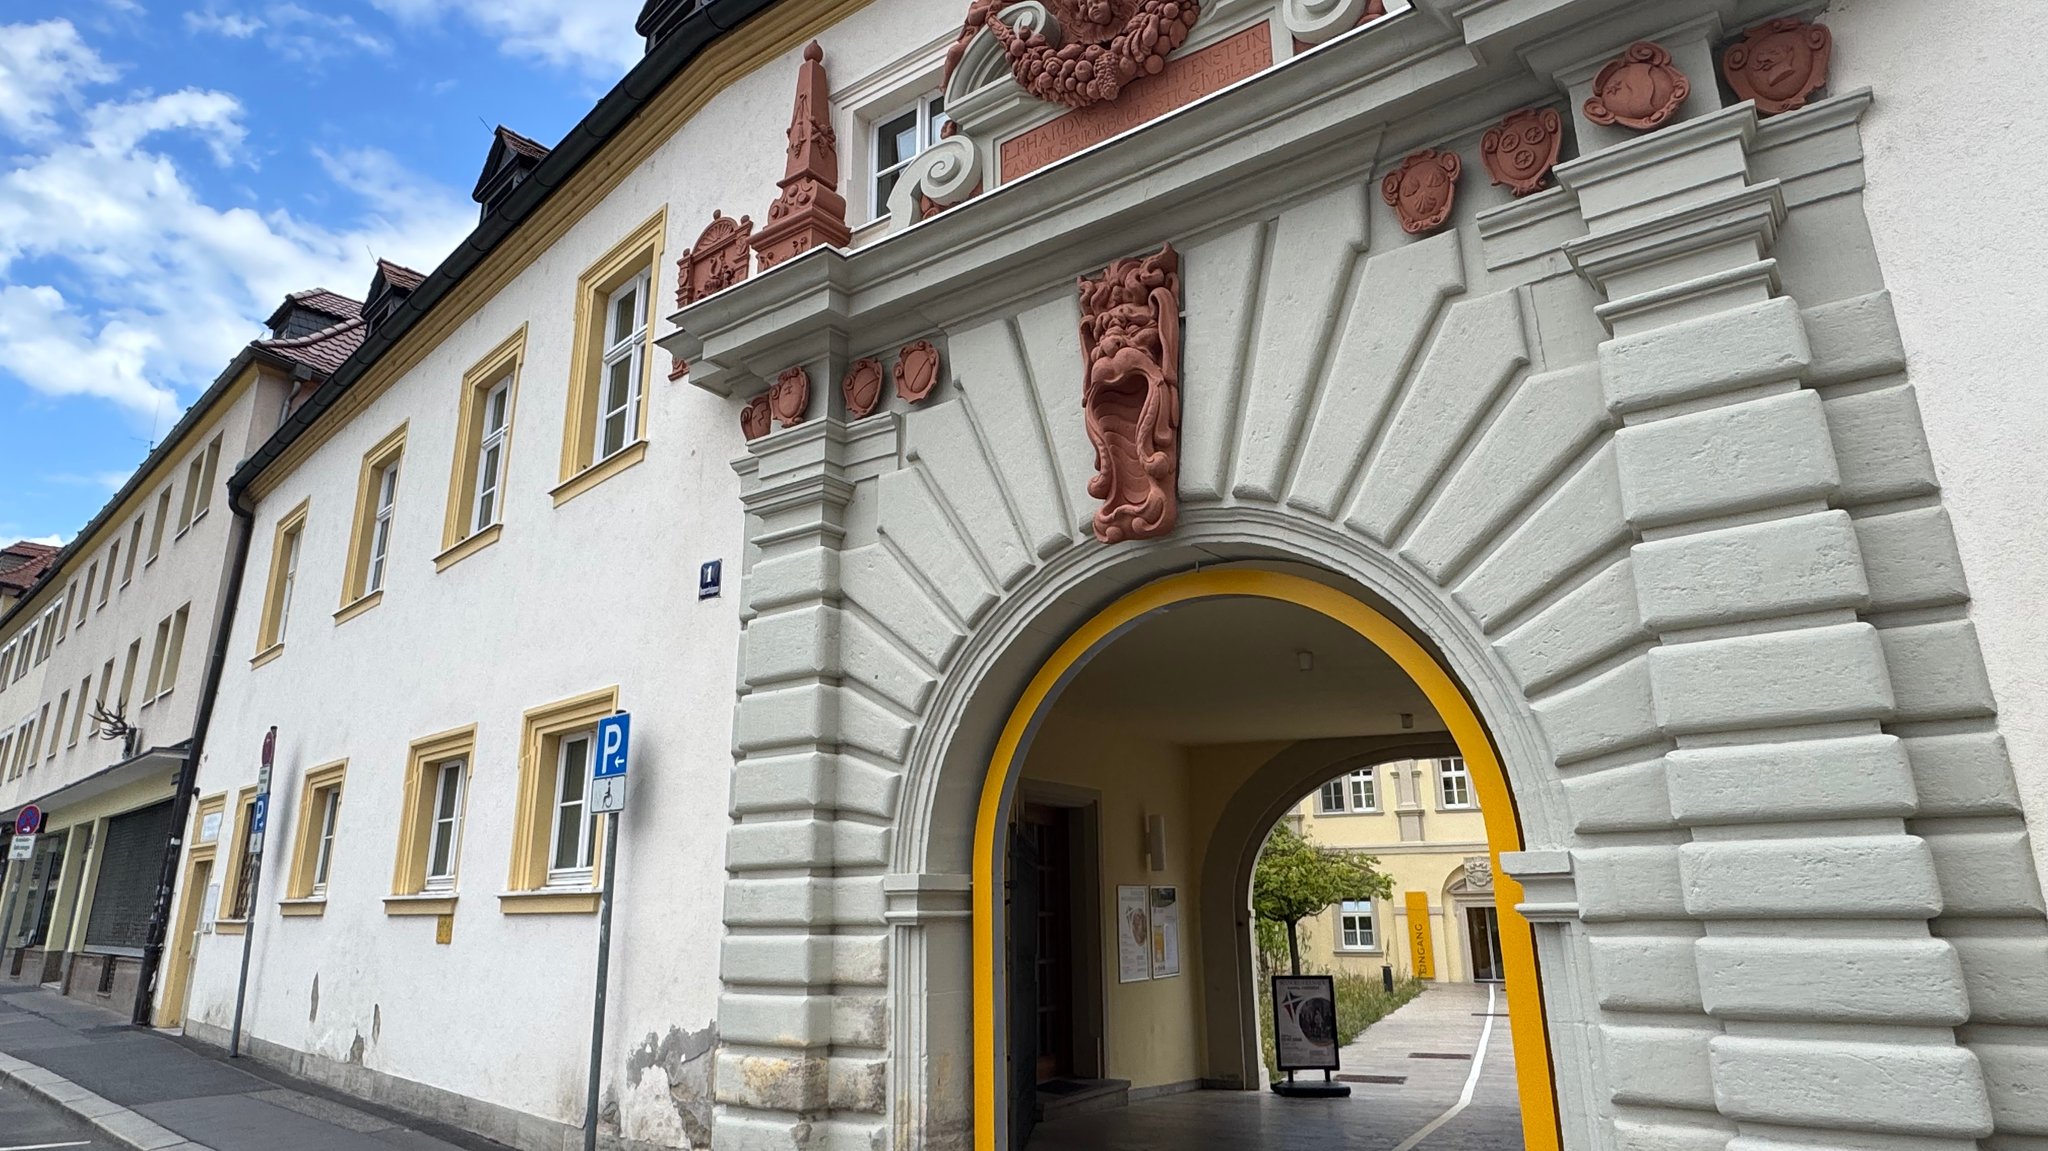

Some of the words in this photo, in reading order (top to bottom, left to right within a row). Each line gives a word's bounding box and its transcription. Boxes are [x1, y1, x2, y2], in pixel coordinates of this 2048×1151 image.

[706, 565, 713, 583] 1
[601, 723, 622, 775] P
[254, 800, 264, 832] P
[1414, 923, 1427, 976] EINGANG
